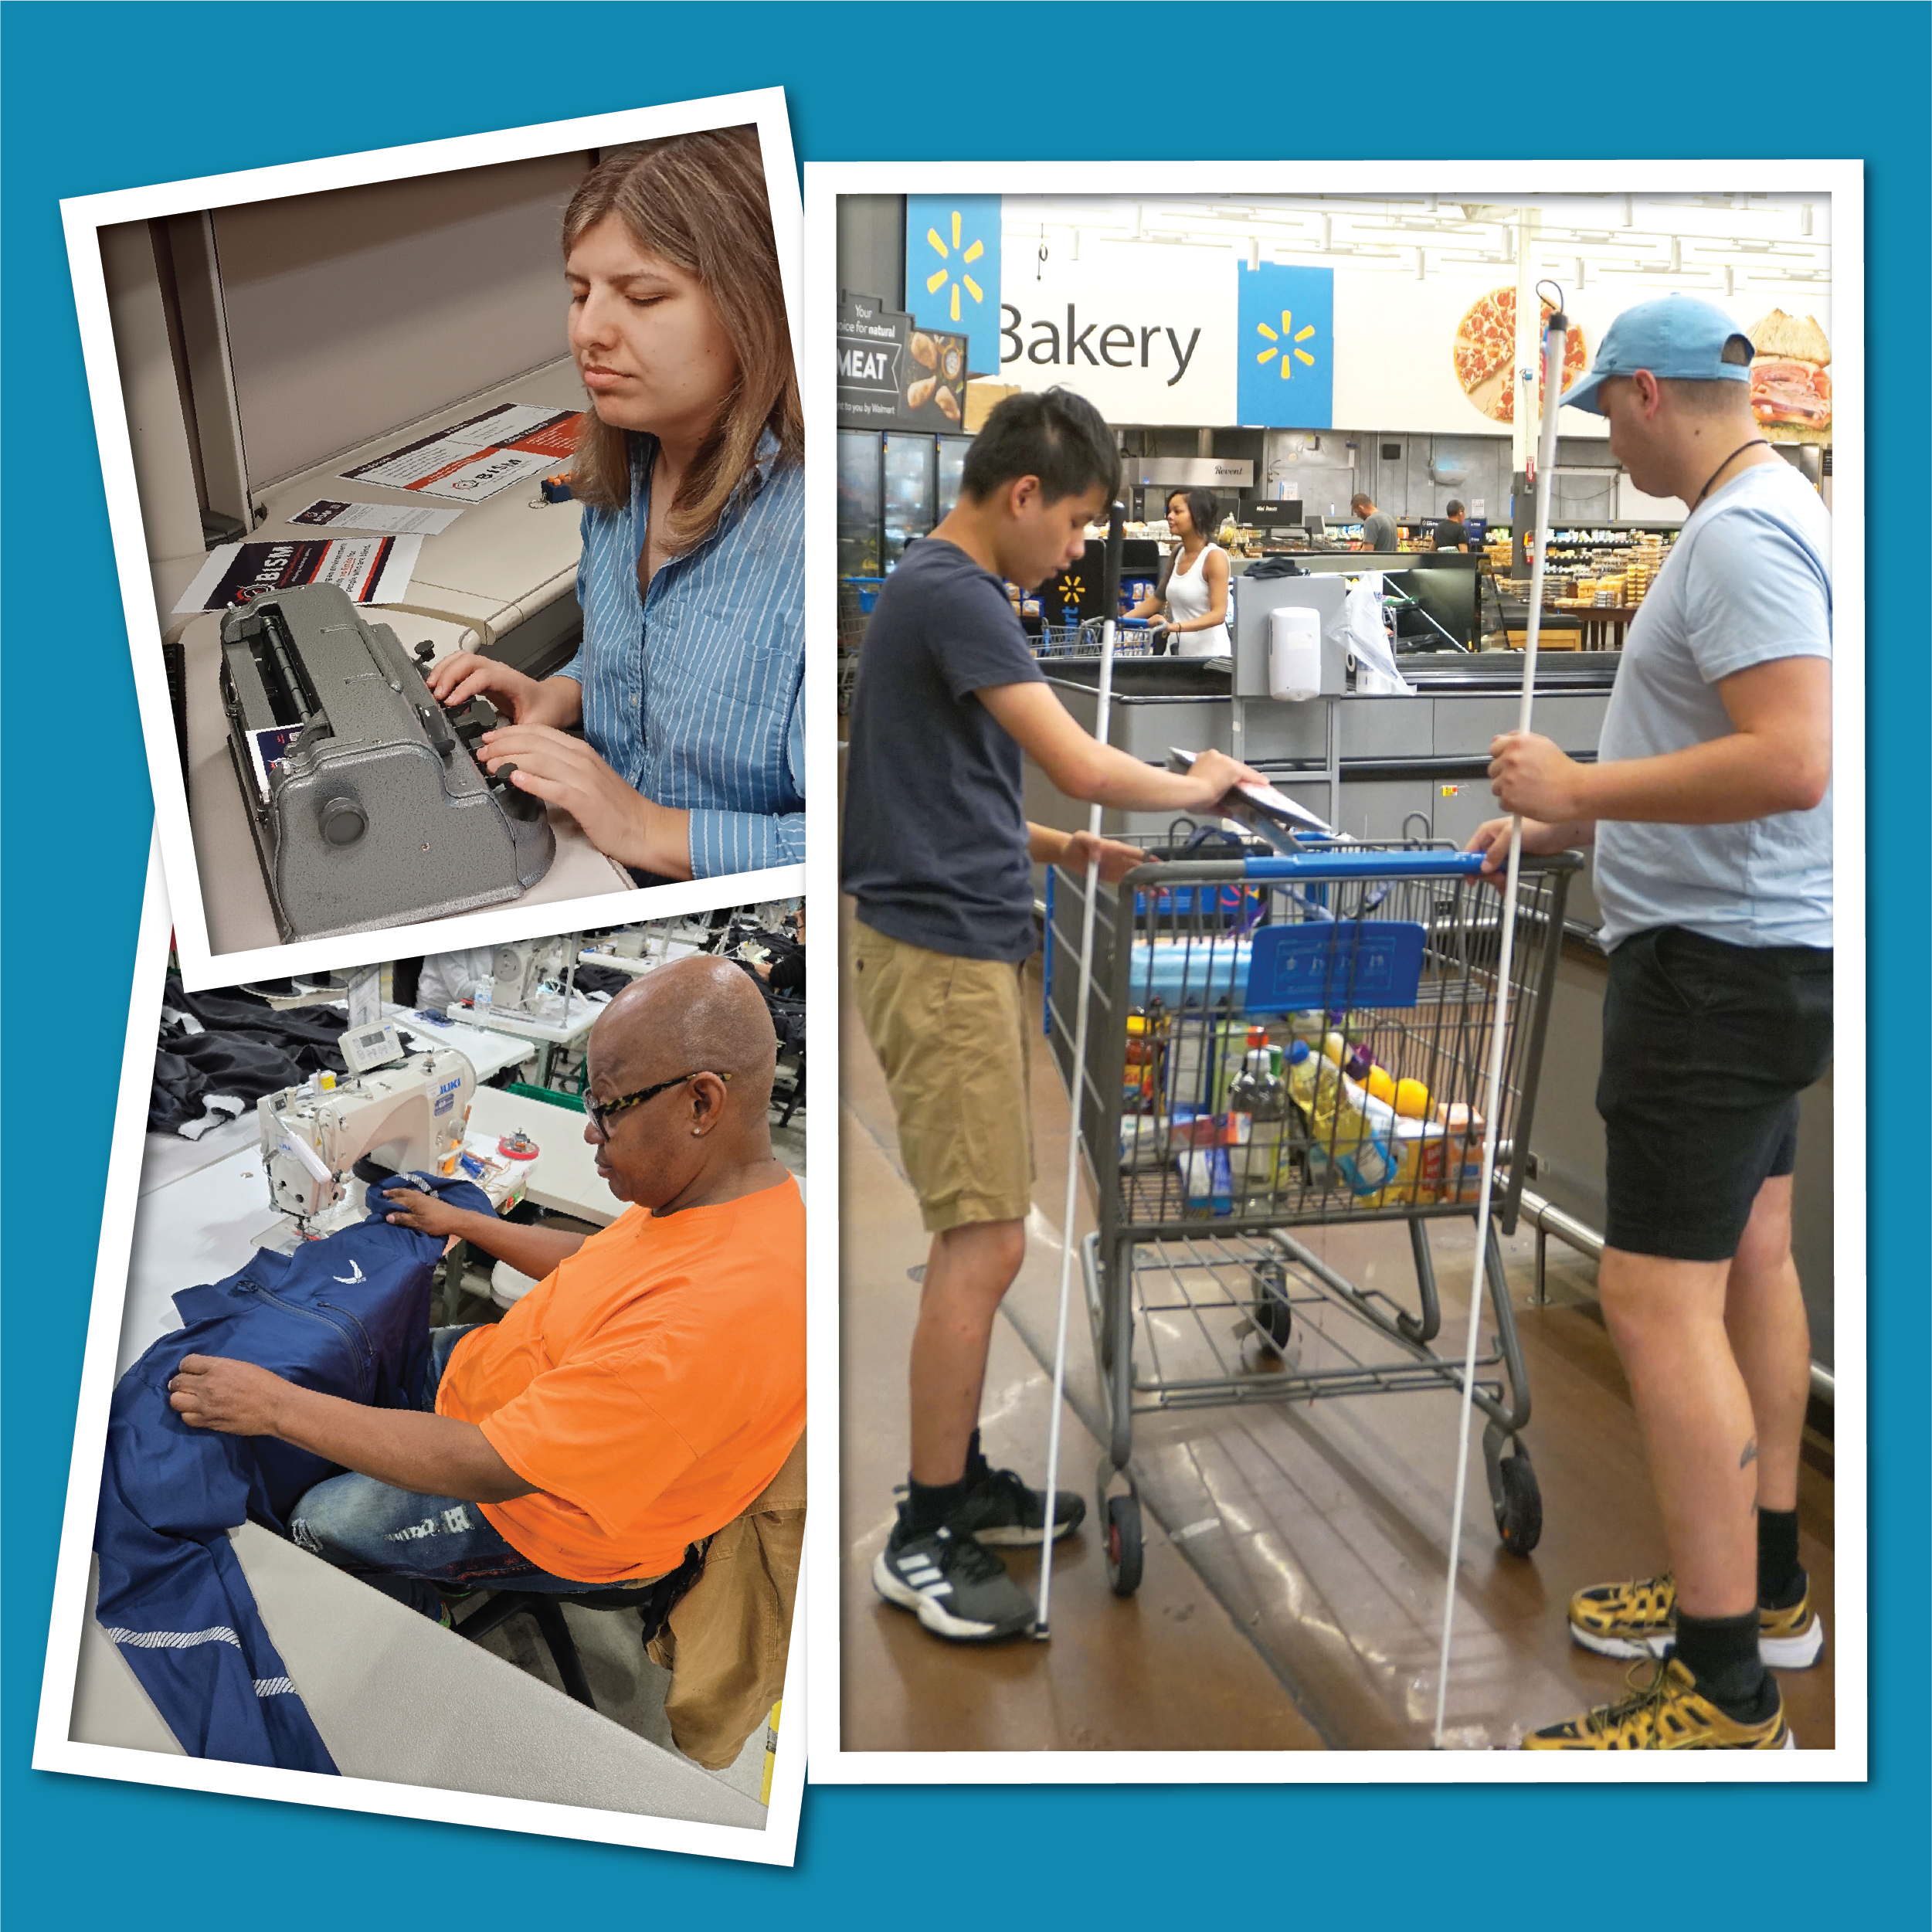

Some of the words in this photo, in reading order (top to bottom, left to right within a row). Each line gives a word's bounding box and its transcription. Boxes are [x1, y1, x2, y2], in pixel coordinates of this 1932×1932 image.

[854, 304, 873, 318] Your
[837, 318, 855, 332] oice
[856, 321, 868, 334] for
[868, 324, 895, 338] natural
[1001, 302, 1202, 386] Bakery
[837, 348, 888, 379] MEAT
[852, 404, 864, 415] you
[864, 402, 871, 415] by
[871, 402, 895, 415] Walmart
[474, 459, 522, 480] BISM
[254, 545, 294, 582] BISM
[437, 1078, 461, 1096] JUKI
